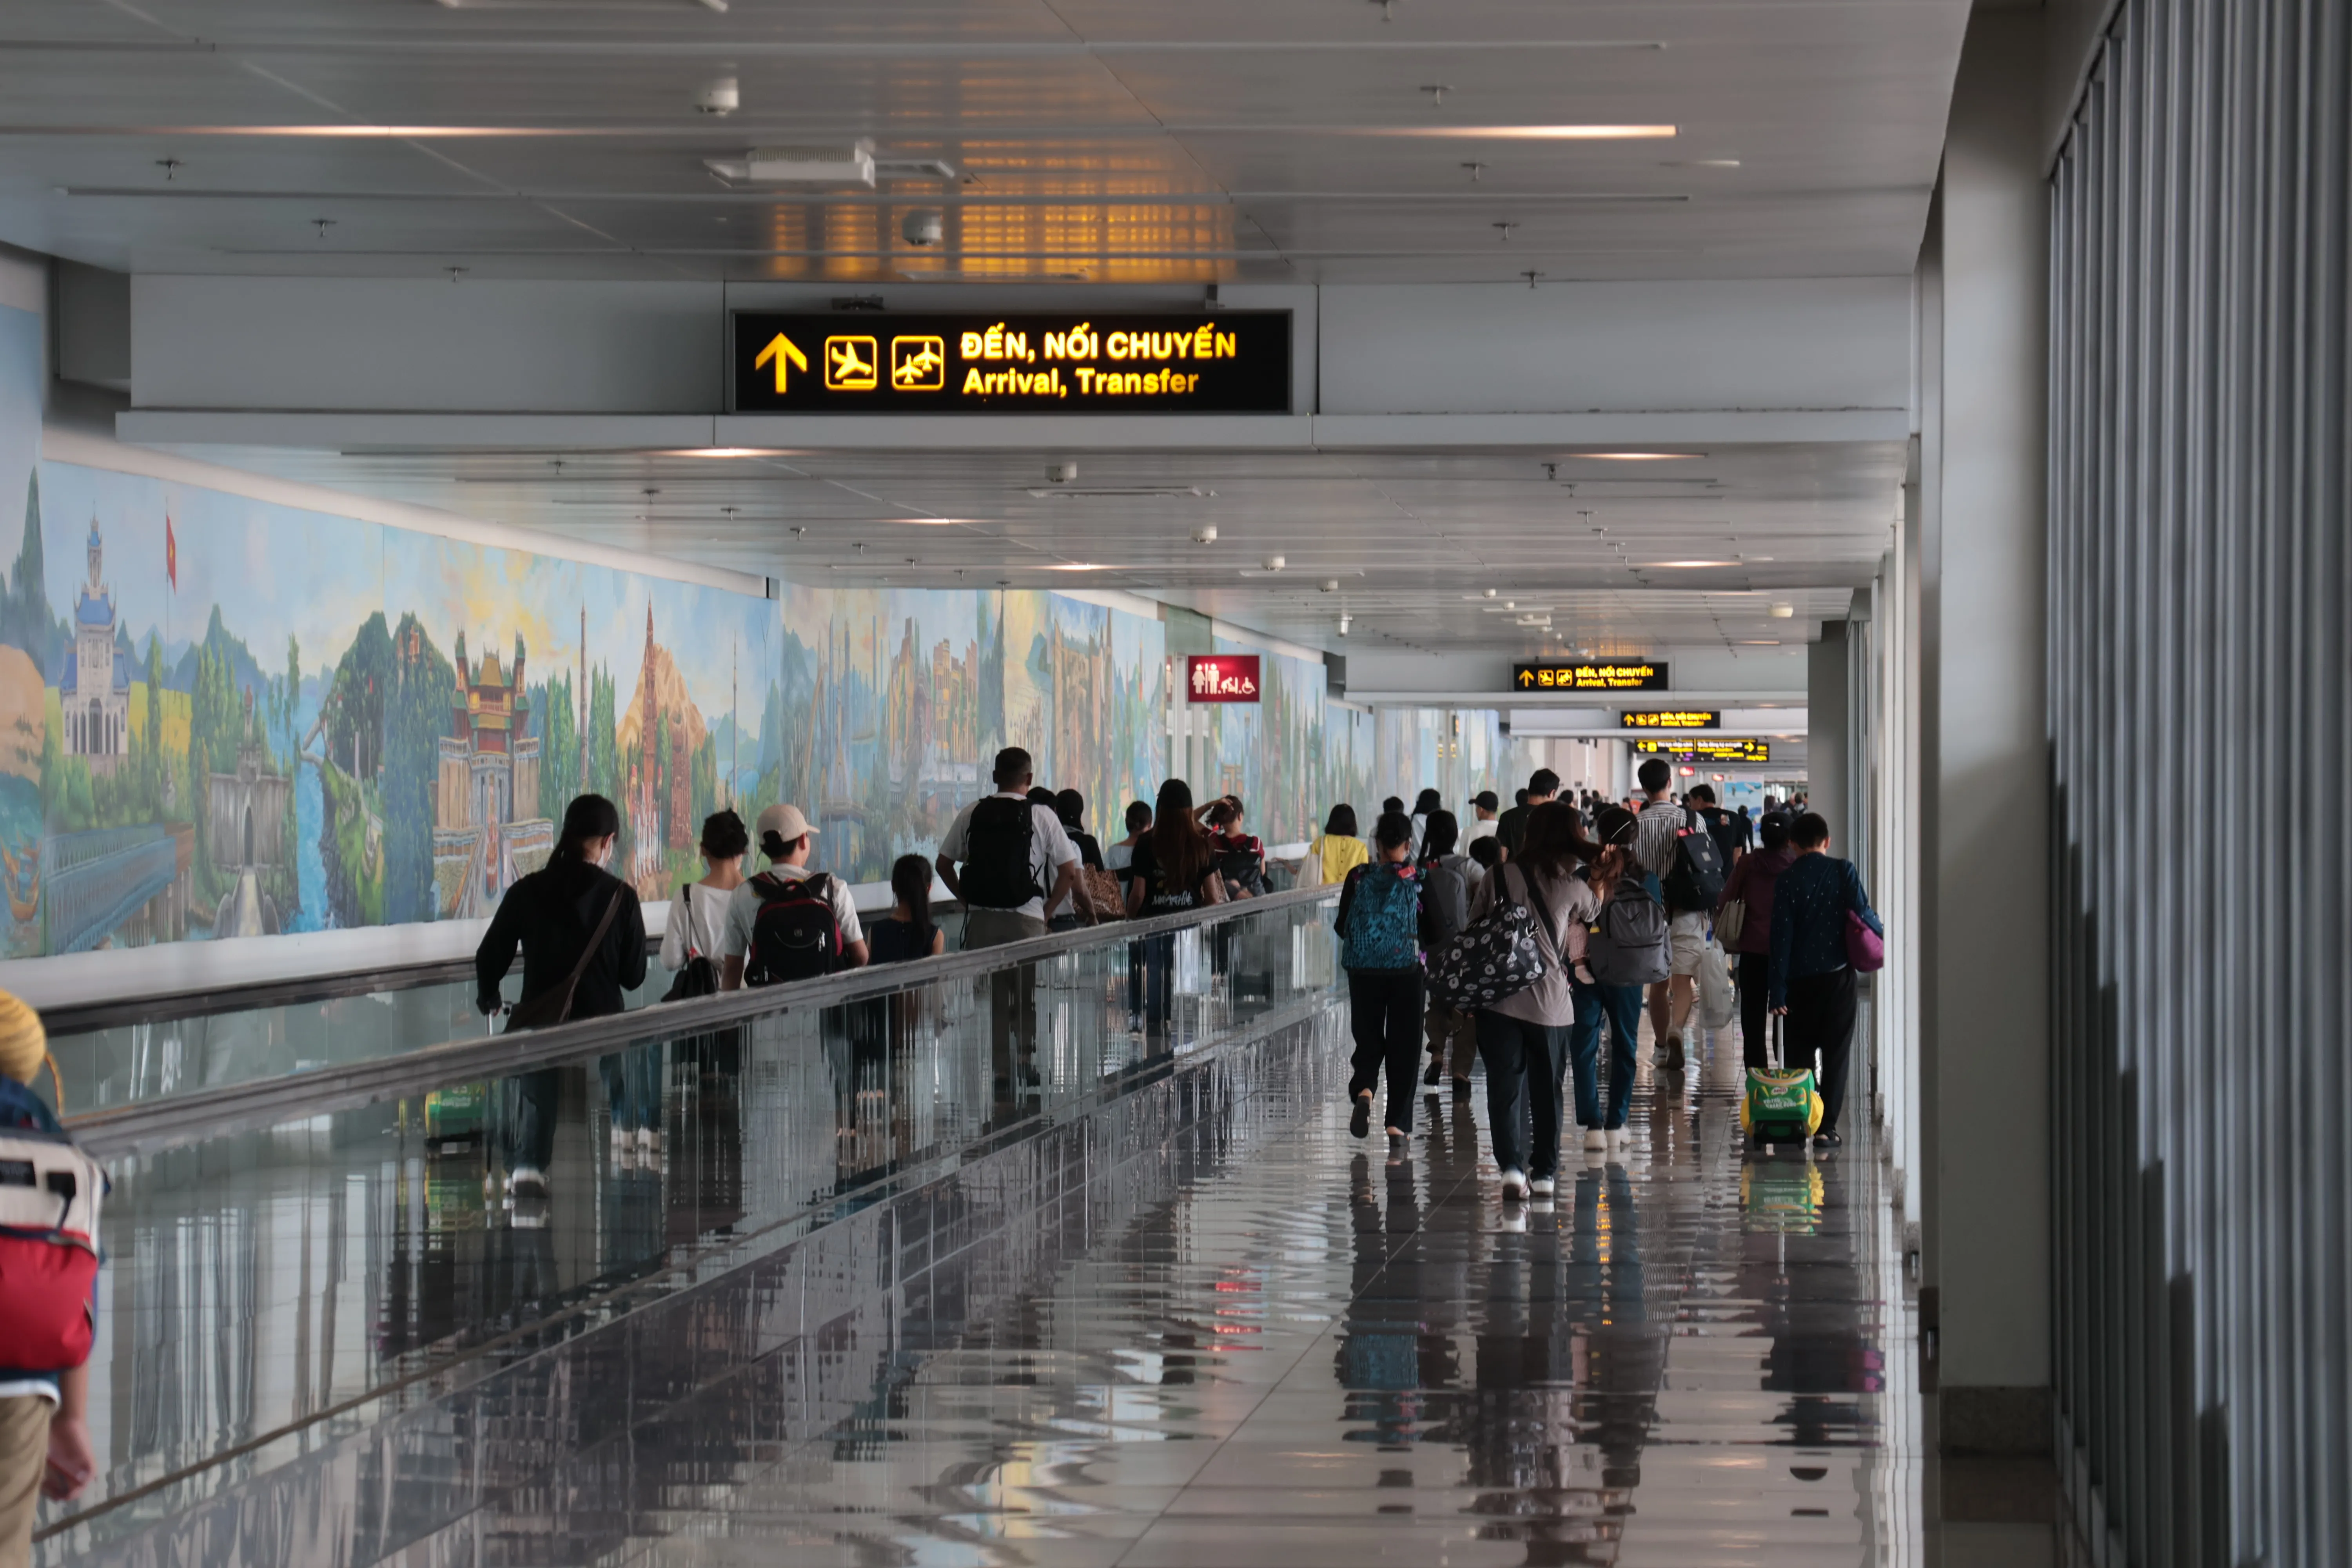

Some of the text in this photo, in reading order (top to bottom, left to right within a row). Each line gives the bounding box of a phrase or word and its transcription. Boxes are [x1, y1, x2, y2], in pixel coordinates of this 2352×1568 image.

[960, 322, 1236, 363] ĐẾN, NỐI CHUYẾN
[962, 367, 1199, 398] Arrival, Transfer
[1576, 678, 1642, 687] Arrival, Transfer
